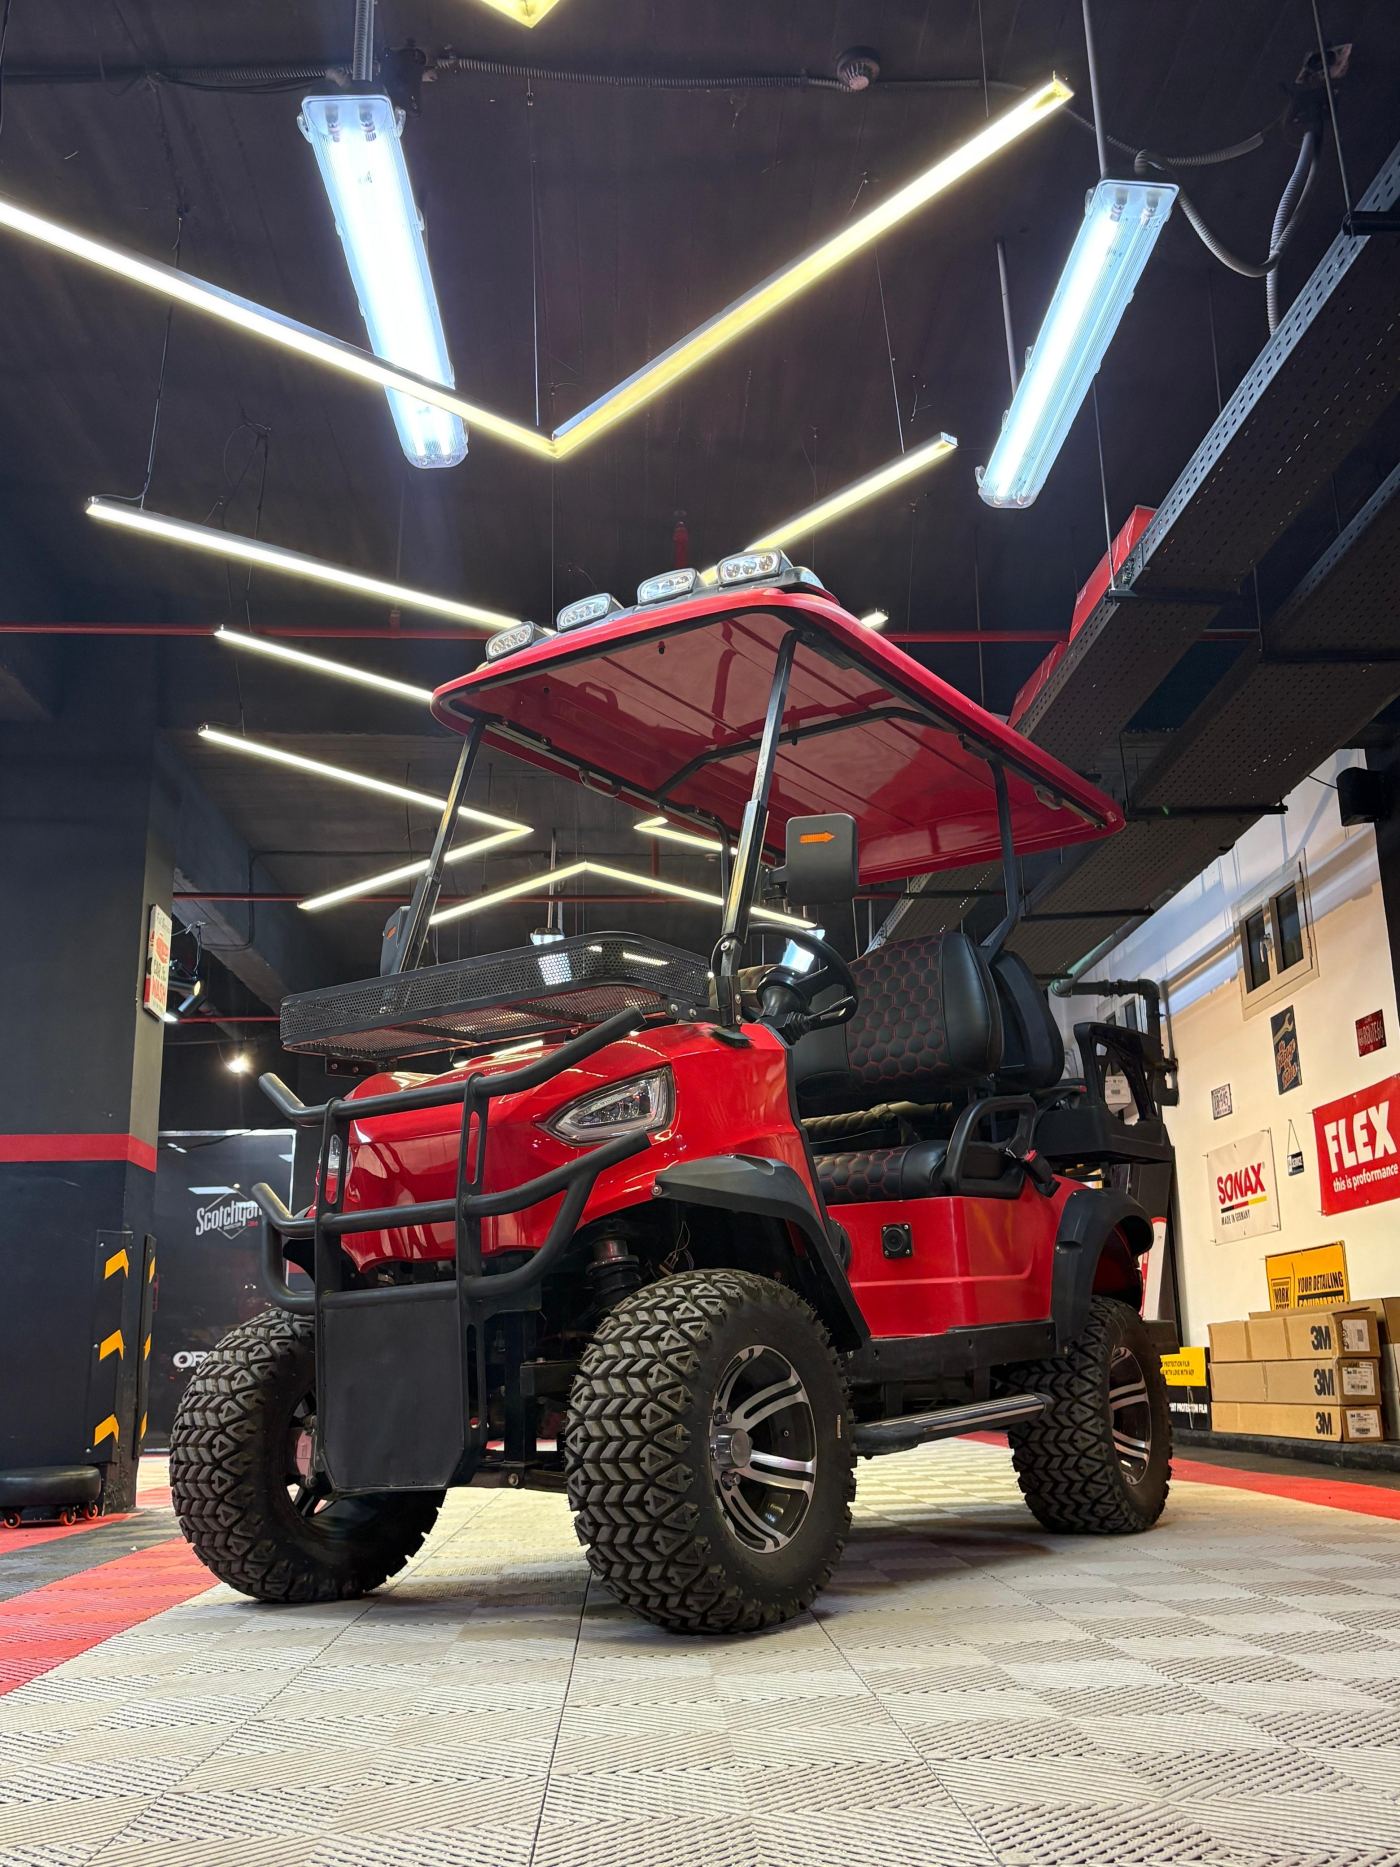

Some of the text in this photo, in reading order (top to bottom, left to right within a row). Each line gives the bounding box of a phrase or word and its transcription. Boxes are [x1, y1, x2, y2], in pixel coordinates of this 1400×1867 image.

[1324, 1100, 1398, 1174] FLEX
[1217, 1162, 1266, 1205] SONAX
[1333, 1163, 1399, 1193] this is proformance
[1274, 1286, 1290, 1303] WORK
[1297, 1271, 1344, 1293] YOUR DETAILING
[1310, 1325, 1332, 1351] 3M
[1313, 1368, 1336, 1396] 3M
[1315, 1411, 1333, 1436] 3M
